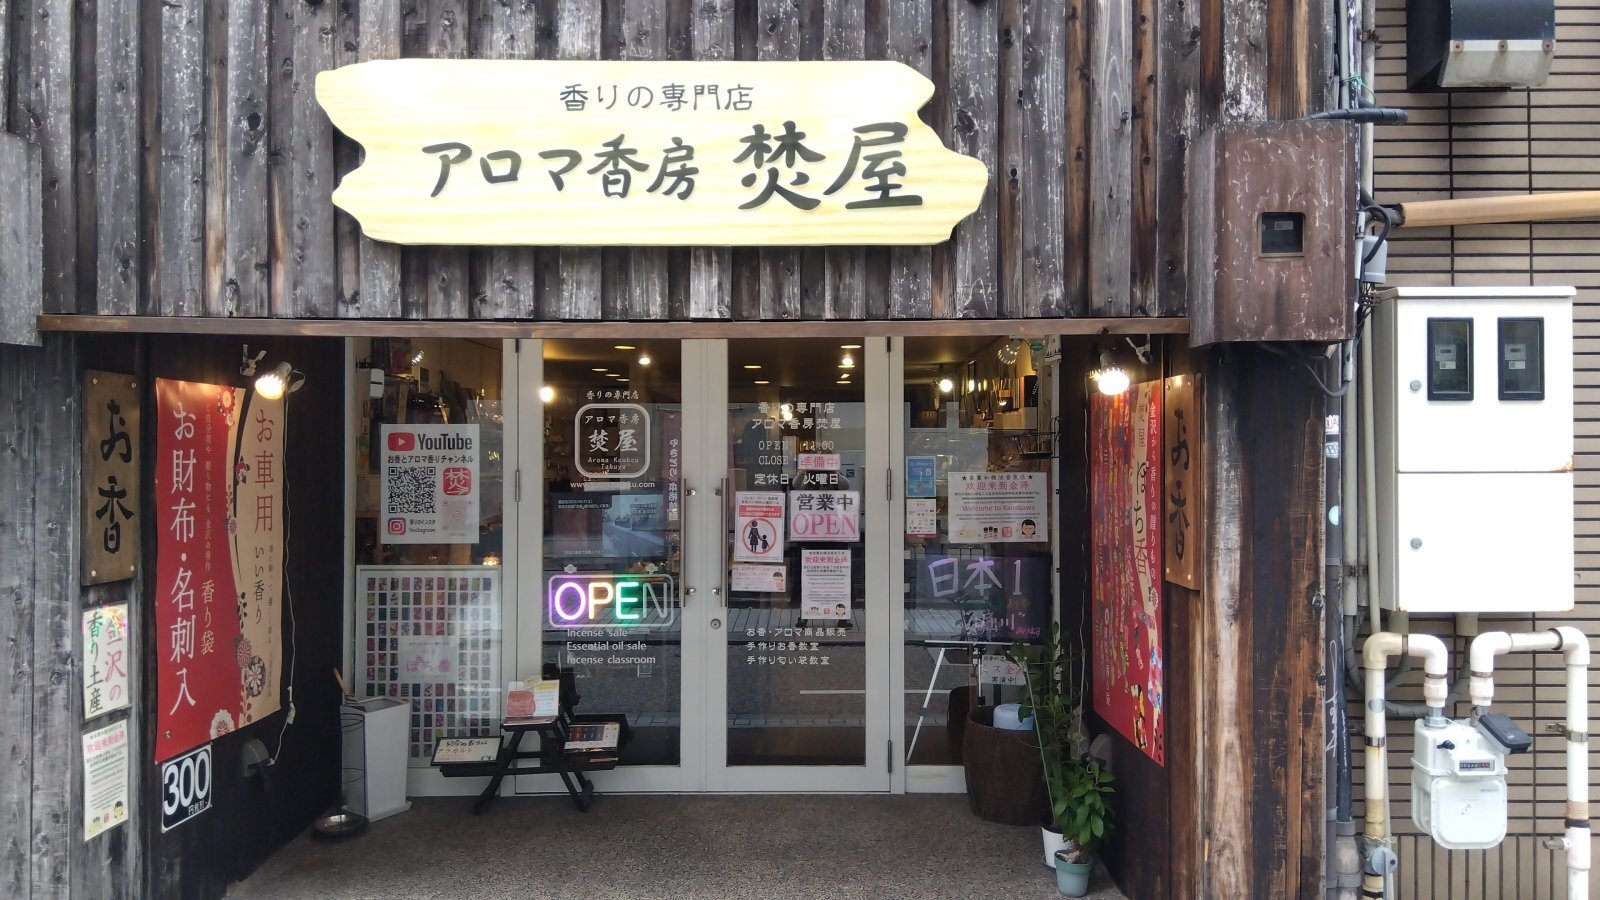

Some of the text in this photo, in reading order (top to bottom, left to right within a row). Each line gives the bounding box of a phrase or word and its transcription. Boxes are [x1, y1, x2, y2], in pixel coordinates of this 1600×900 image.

[559, 83, 755, 112] 香りの専門店
[421, 120, 923, 211] アロマ香房 焚屋
[586, 390, 640, 400] 香りの専門店
[584, 413, 640, 425] アロマ香房
[417, 432, 473, 451] YouTube
[587, 428, 638, 453] 焚屋
[758, 440, 789, 451] OPEN
[387, 454, 474, 464] お香とアロマ香りチャンネル
[758, 456, 789, 466] CLOSE
[96, 399, 135, 554] お香
[254, 408, 275, 533] お車用
[754, 473, 839, 485] 定休日 火曜日
[1169, 407, 1190, 561] お香
[796, 493, 854, 512] 営業中
[791, 513, 858, 536] OPEN
[252, 545, 266, 625] いい香り
[554, 581, 668, 621] OPEN
[200, 579, 215, 656] 香り袋
[567, 627, 628, 637] Incense sale
[746, 627, 847, 637] お香・アロマ商品販売
[566, 640, 647, 651] Essential oil sale
[746, 641, 819, 651] 手作りお香教室
[86, 605, 104, 715] 香り土産
[104, 610, 127, 702] 金沢の
[566, 654, 656, 664] Incense classroom
[746, 656, 830, 665] 手作り匂い袋教室
[163, 750, 210, 816] 300
